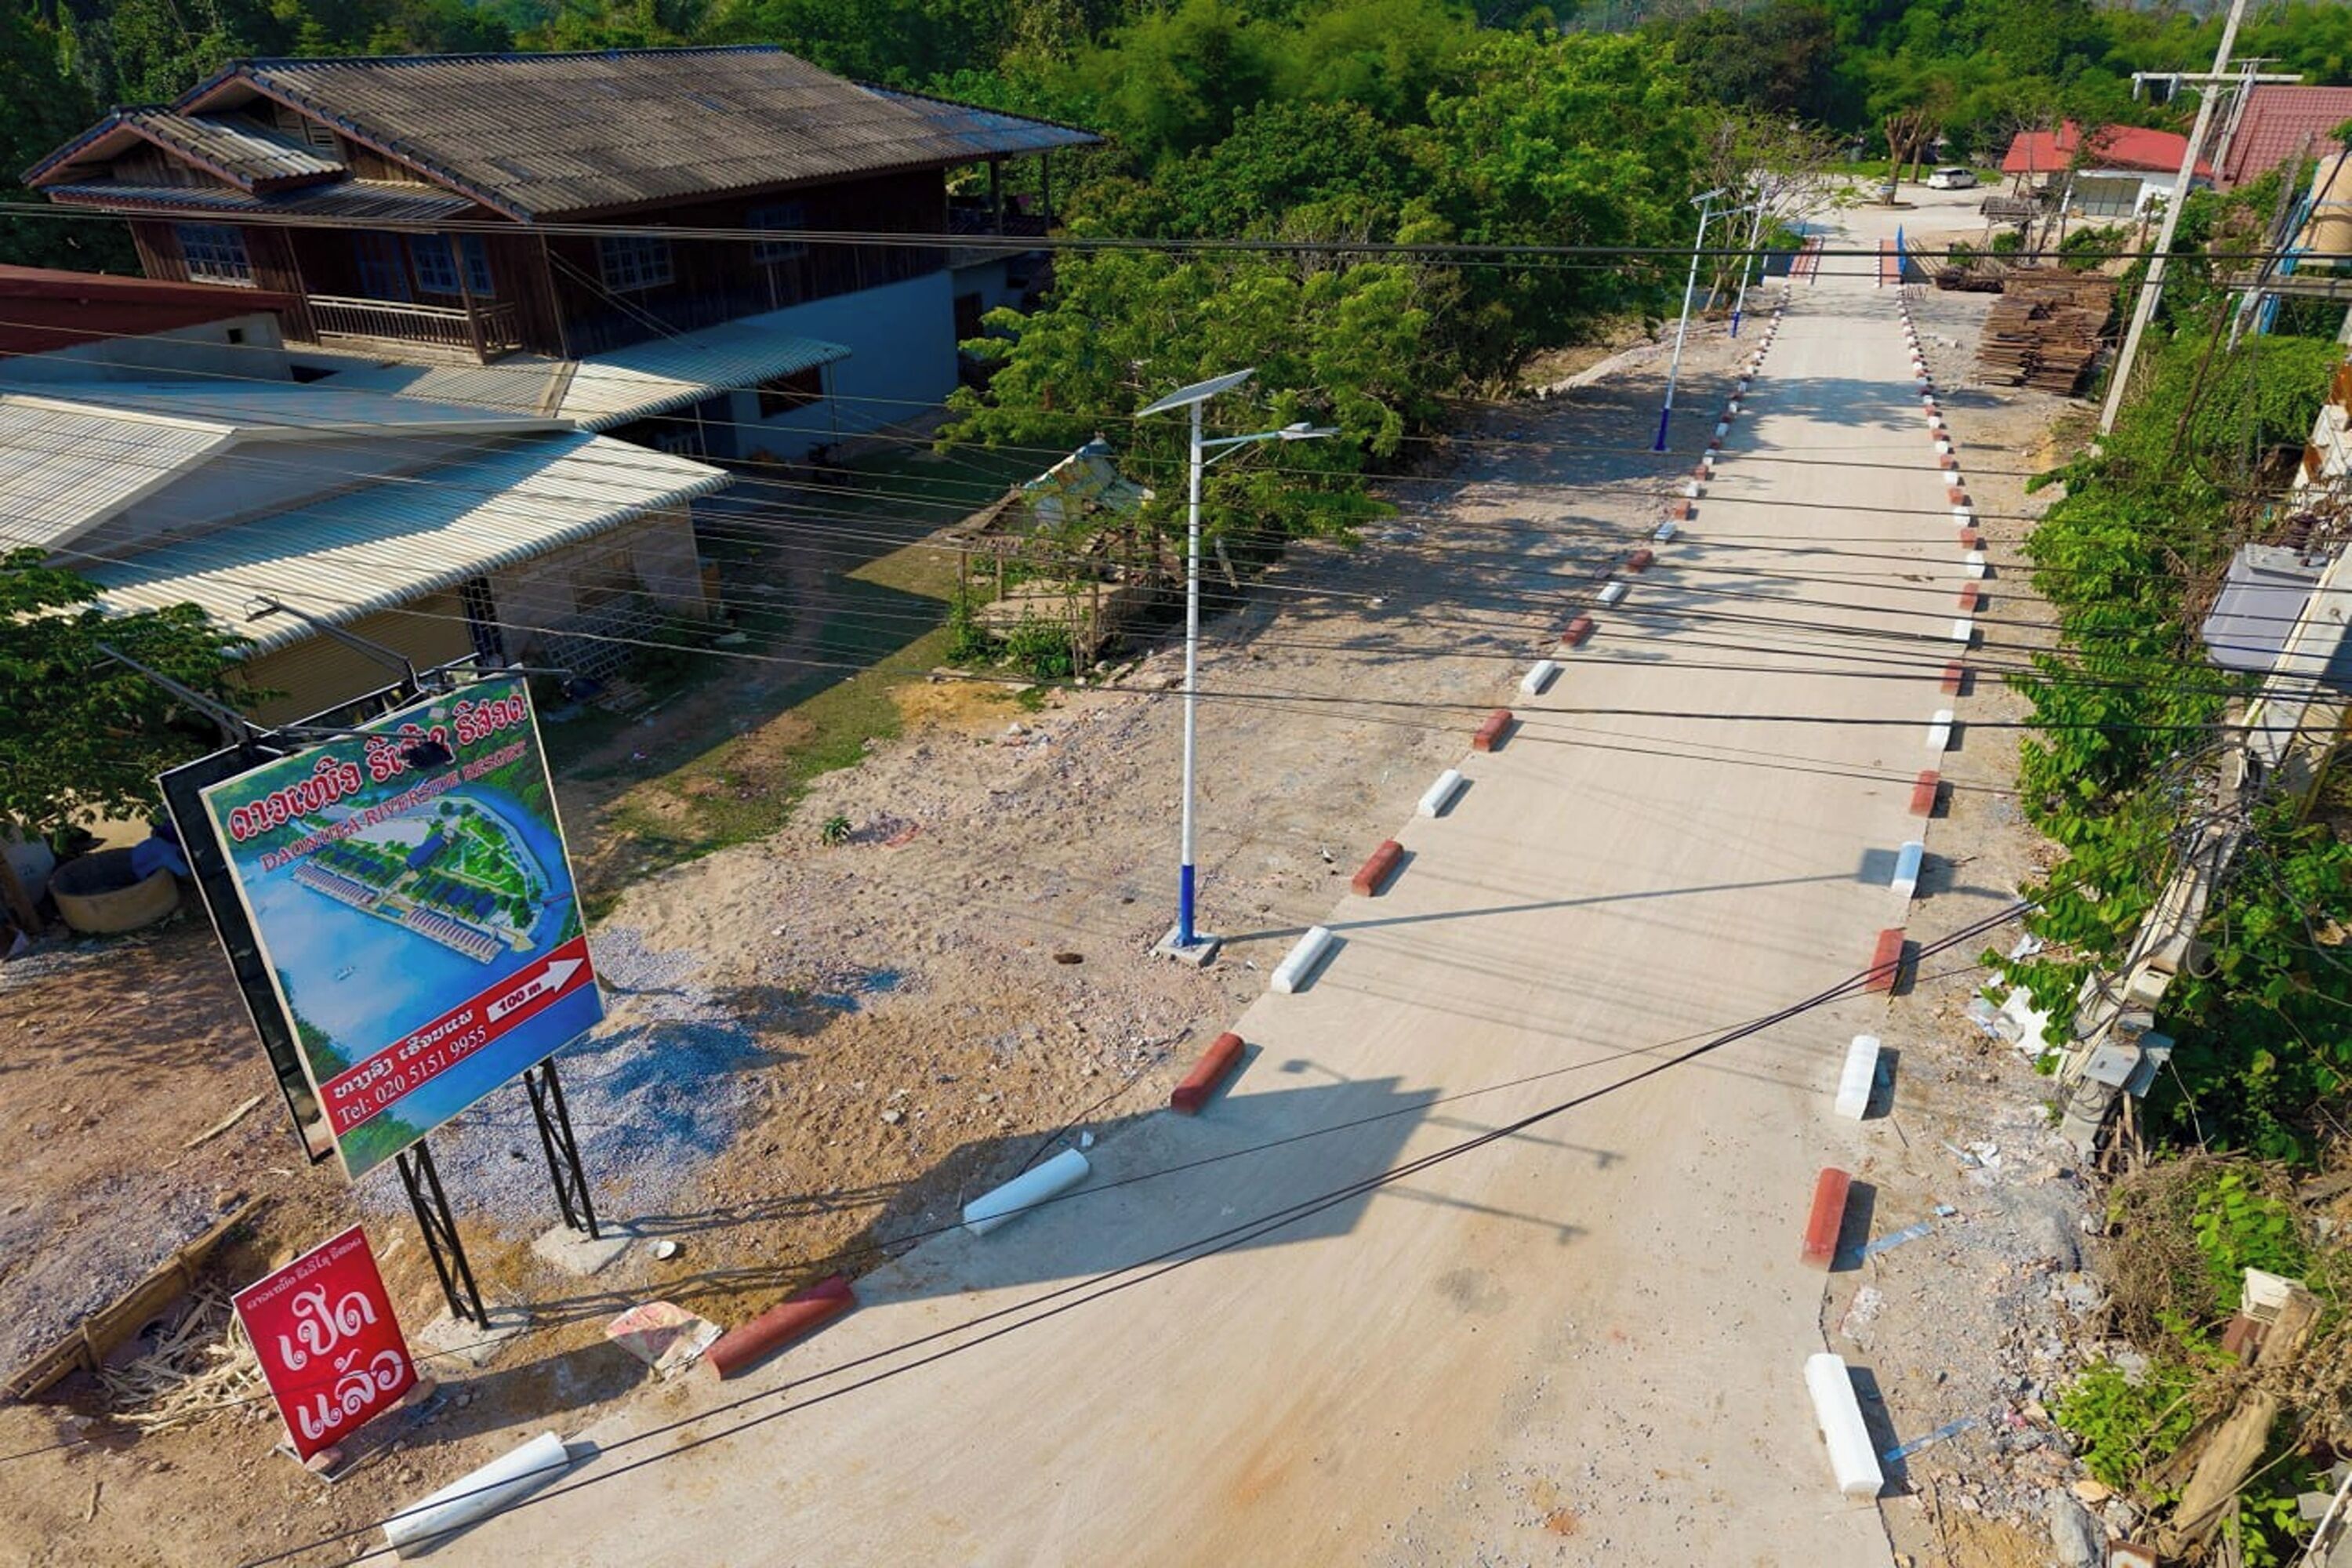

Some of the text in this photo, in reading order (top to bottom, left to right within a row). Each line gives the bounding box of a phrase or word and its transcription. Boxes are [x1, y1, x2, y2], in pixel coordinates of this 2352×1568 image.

[363, 770, 461, 826] RIVERSIDE
[460, 740, 527, 782] RESORT
[497, 982, 542, 1011] 100 m
[337, 1024, 487, 1126] Tel: 020 5151 9955
[296, 1348, 404, 1440] ແລ້ວ
